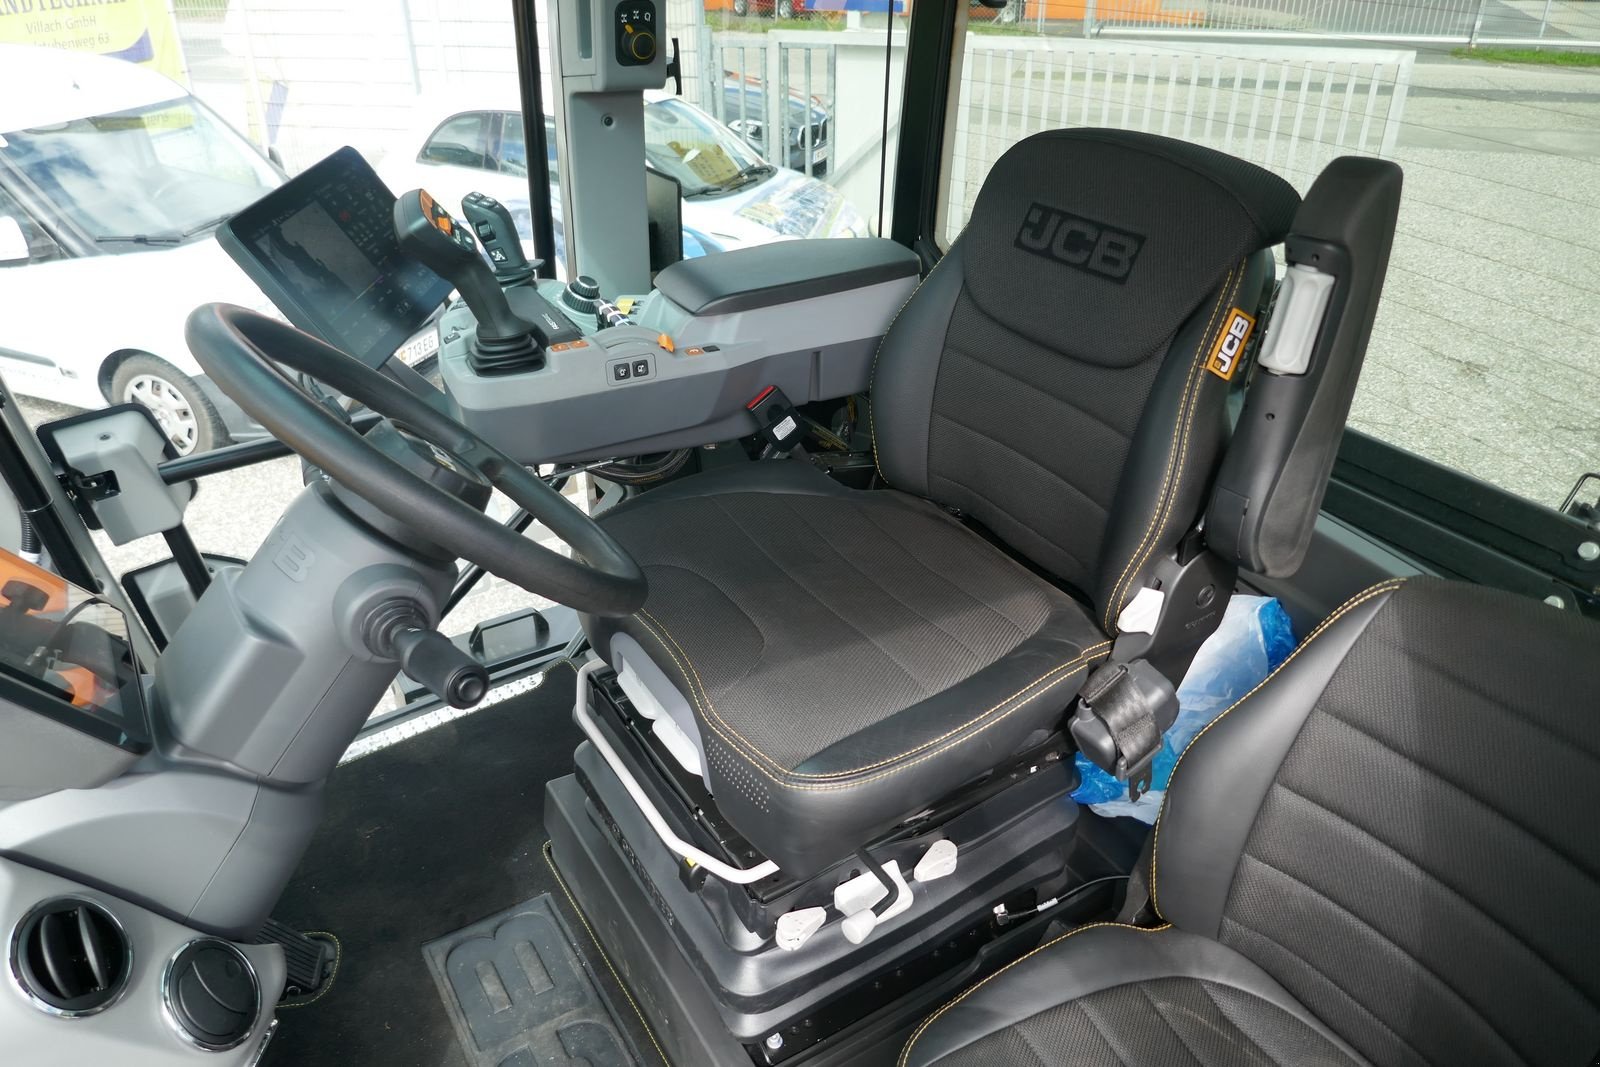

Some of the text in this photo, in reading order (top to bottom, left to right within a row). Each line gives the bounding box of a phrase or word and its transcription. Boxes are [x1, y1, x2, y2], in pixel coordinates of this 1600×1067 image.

[26, 16, 97, 35] Villach GmbH
[97, 33, 111, 45] 63
[1018, 206, 1140, 280] JCB
[1216, 316, 1250, 373] JCB
